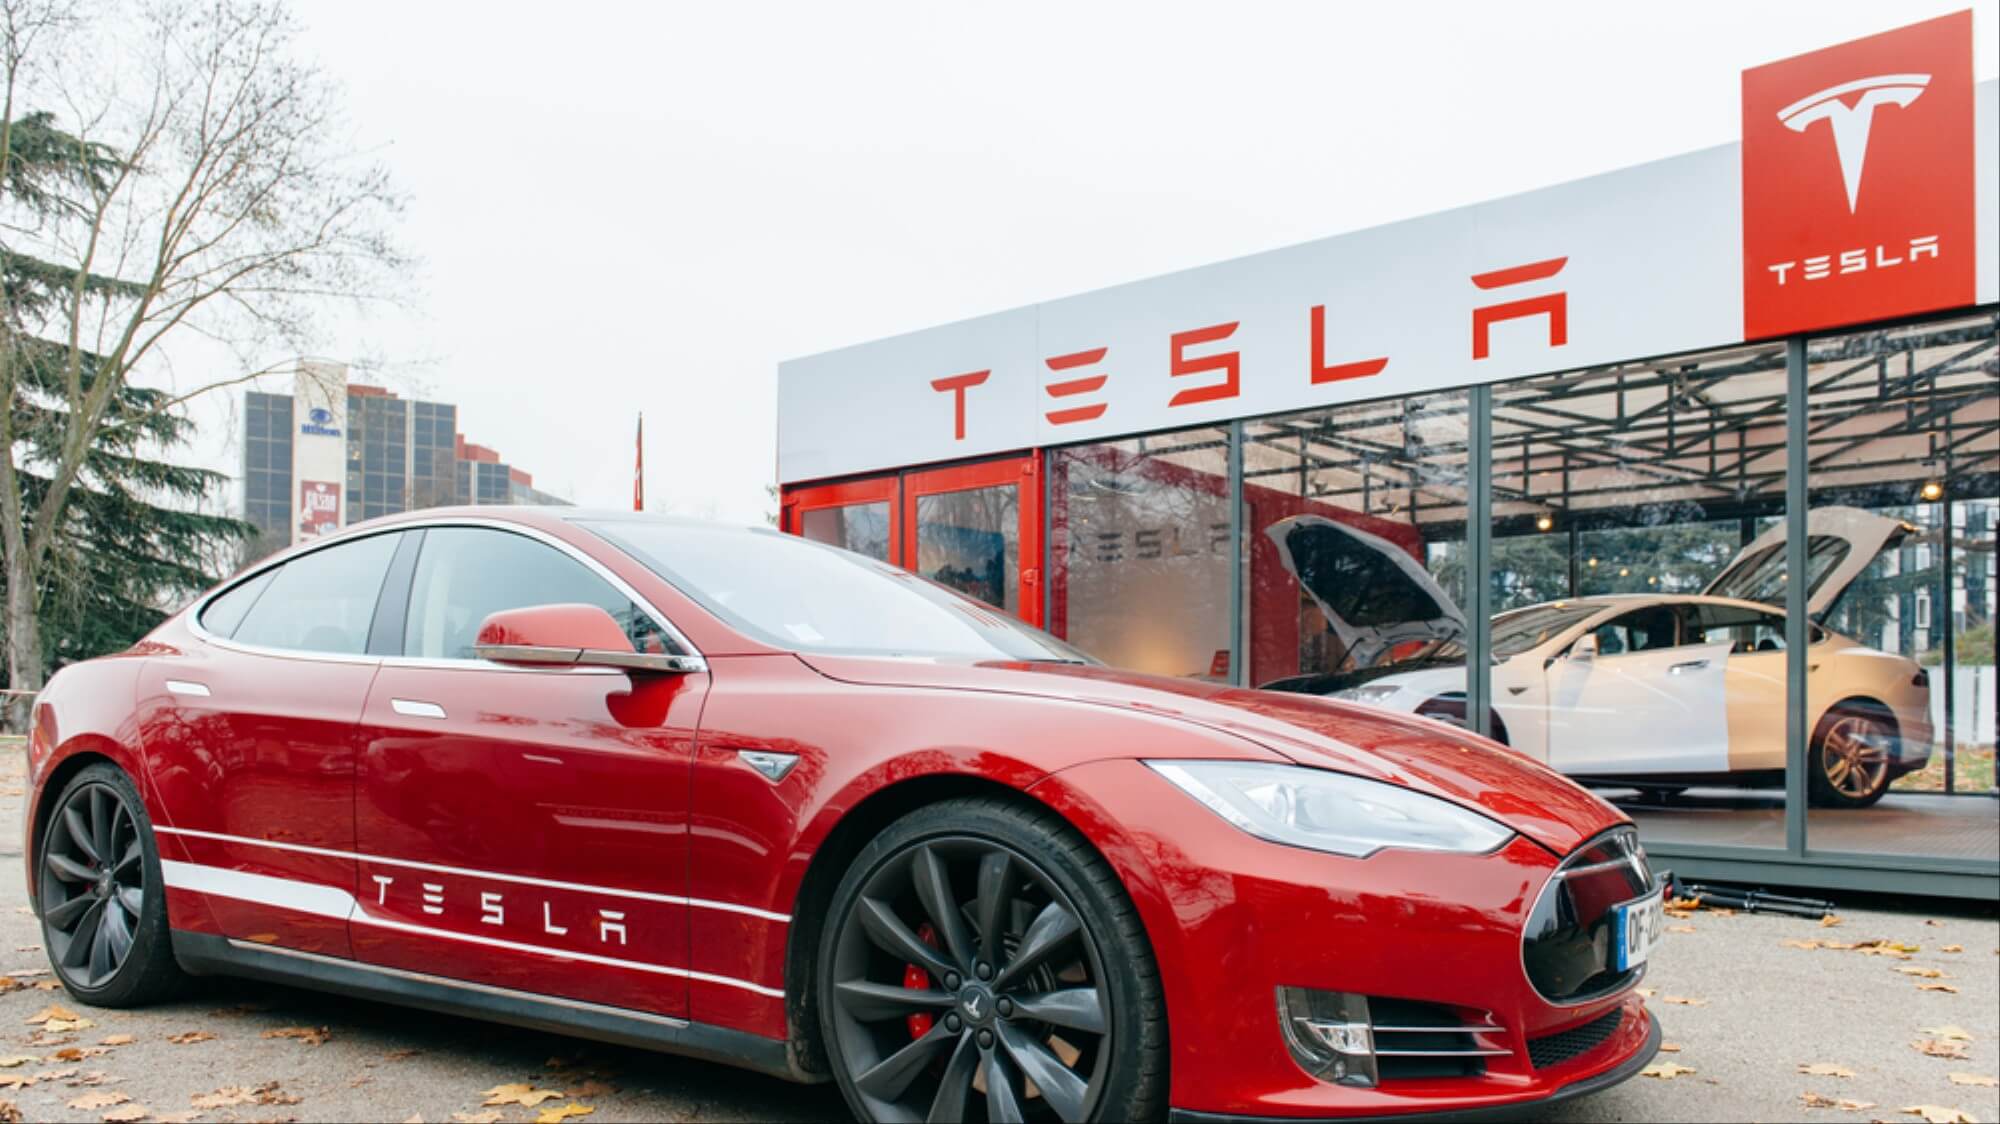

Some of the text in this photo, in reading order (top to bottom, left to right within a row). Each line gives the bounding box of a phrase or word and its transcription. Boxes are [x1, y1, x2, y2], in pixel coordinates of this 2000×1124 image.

[1768, 235, 1938, 285] TESLA
[930, 256, 1568, 440] TESLA
[372, 875, 627, 945] TESLA
